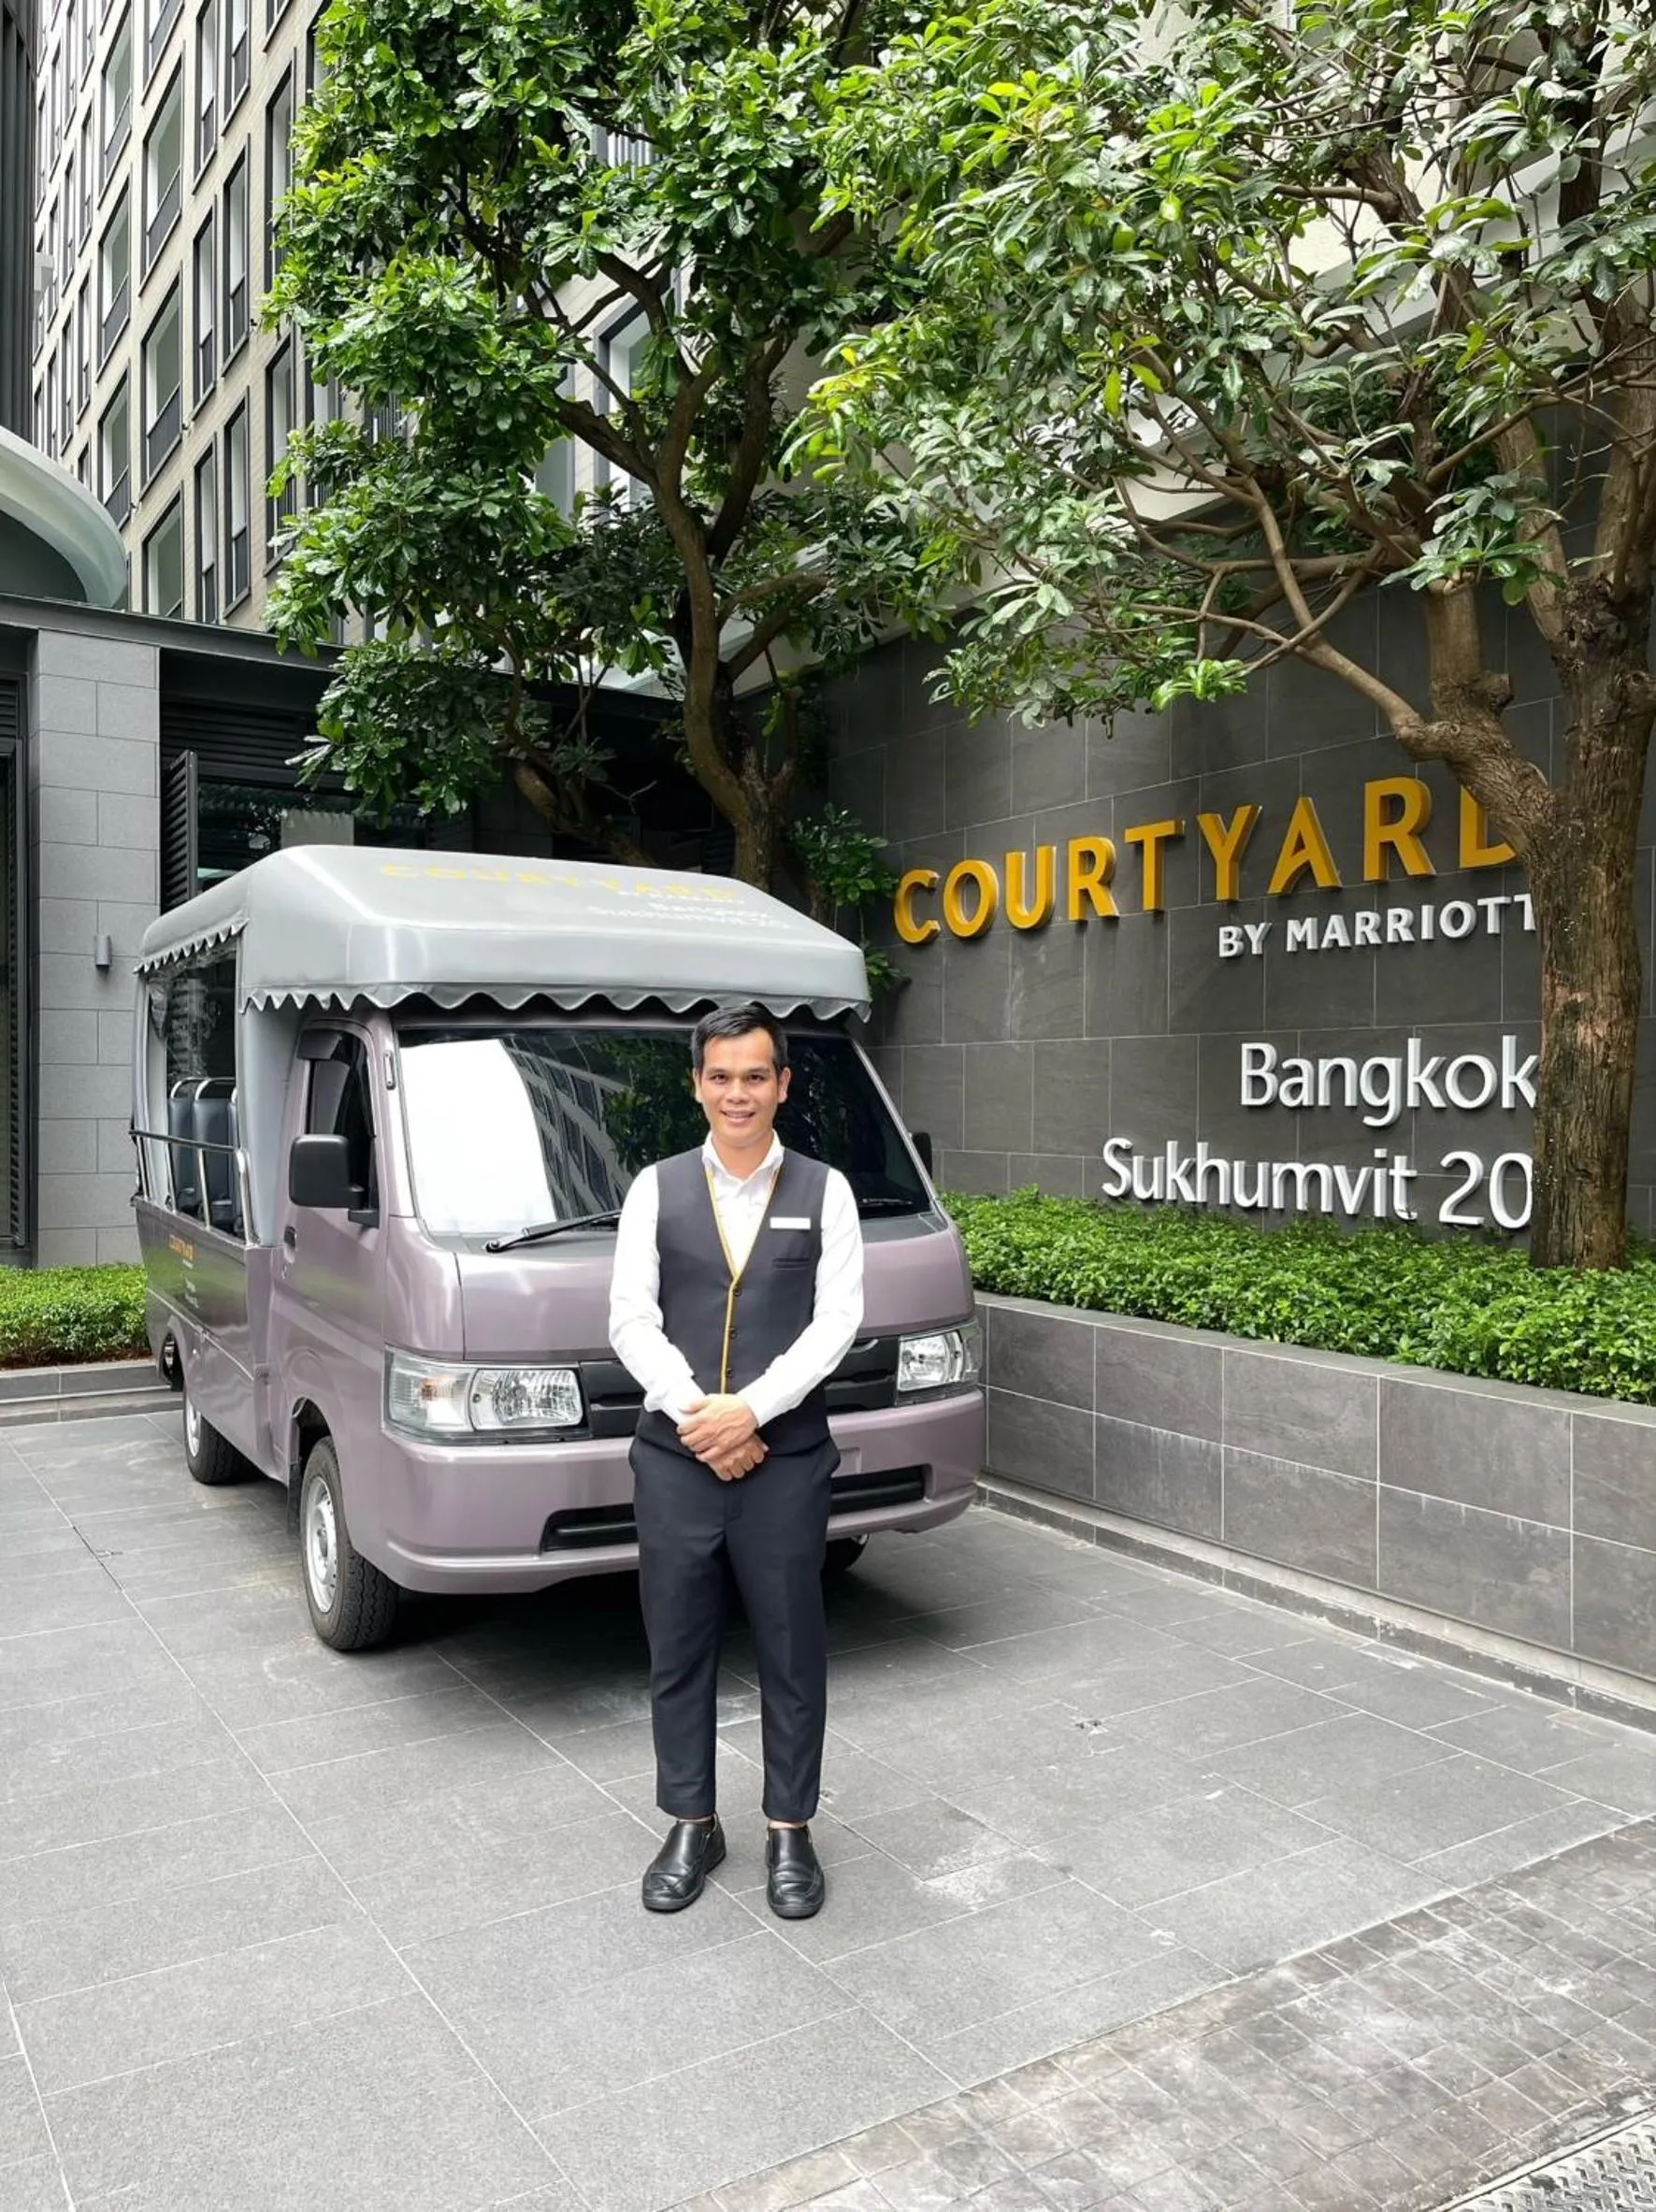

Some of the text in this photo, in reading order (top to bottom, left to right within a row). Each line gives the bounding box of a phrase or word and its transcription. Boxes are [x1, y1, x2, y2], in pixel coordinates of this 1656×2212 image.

[1218, 893, 1536, 958] BY MARRIOTT
[1240, 1034, 1539, 1128] Bangkok
[1102, 1137, 1534, 1229] Sukhumvit 20
